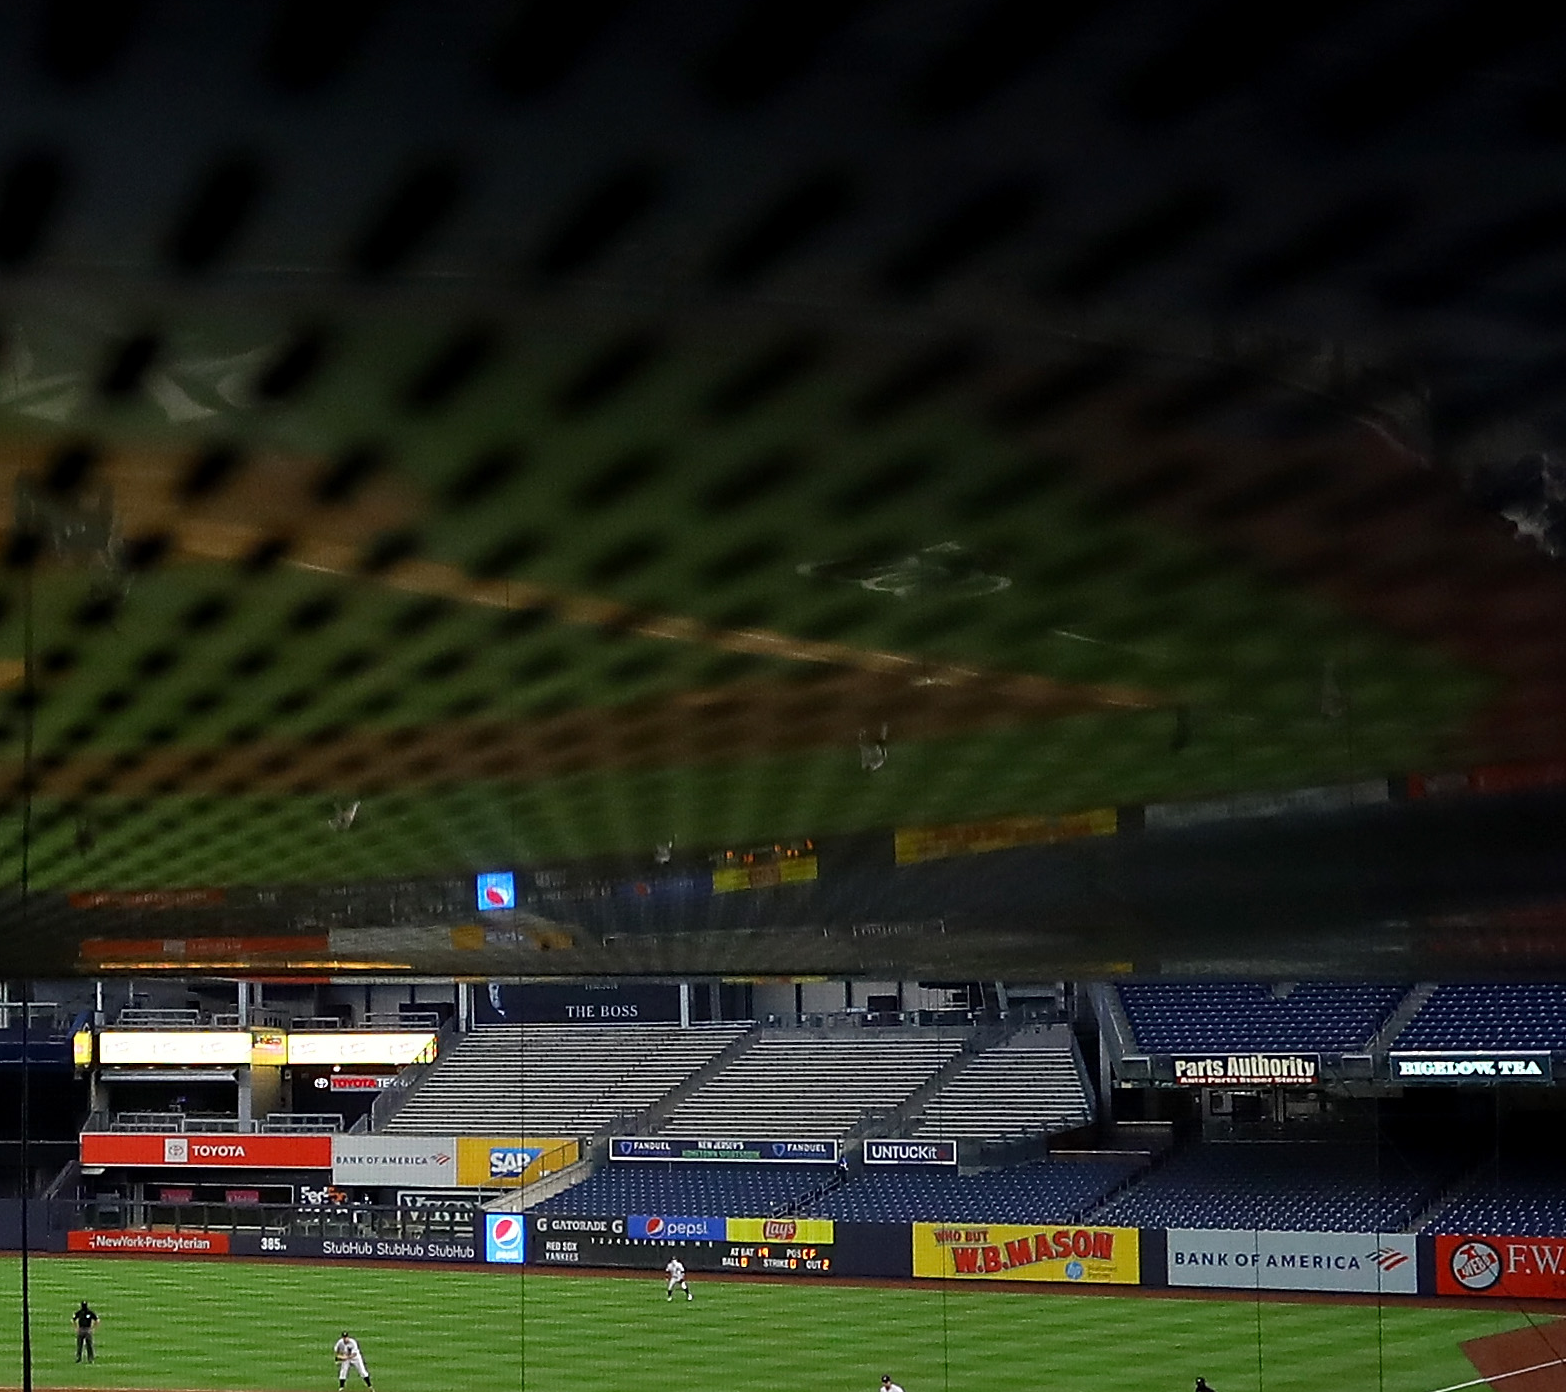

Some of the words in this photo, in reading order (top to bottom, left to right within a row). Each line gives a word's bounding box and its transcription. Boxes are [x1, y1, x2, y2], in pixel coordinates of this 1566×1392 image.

[565, 1005, 595, 1018] THE
[600, 1004, 639, 1018] BOSS
[1175, 1058, 1225, 1077] Parts
[1226, 1055, 1316, 1078] Authority
[1498, 1062, 1542, 1077] TEA
[331, 1077, 376, 1089] TOYOTA
[191, 1145, 245, 1157] TOYOTA
[633, 1141, 671, 1151] FANDUEL
[787, 1143, 827, 1153] FANDUEL
[871, 1145, 938, 1160] UNTUCKit
[335, 1156, 365, 1165] BANK
[366, 1156, 380, 1165] OF
[380, 1156, 429, 1166] AMERICA
[490, 1152, 532, 1174] SAP
[552, 1220, 607, 1232] GATORADE
[667, 1221, 708, 1237] pepsi
[934, 1229, 962, 1244] WHO
[964, 1229, 990, 1243] BUT
[260, 1237, 281, 1251] 385
[323, 1241, 373, 1255] StubHub
[376, 1242, 424, 1257] StubHub
[427, 1243, 475, 1258] StubHub
[546, 1241, 561, 1252] RED
[562, 1241, 578, 1252] SOX
[1174, 1251, 1229, 1266] BANK
[1234, 1252, 1261, 1267] OF
[1265, 1254, 1361, 1270] AMERICA
[1505, 1244, 1566, 1275] F.W.
